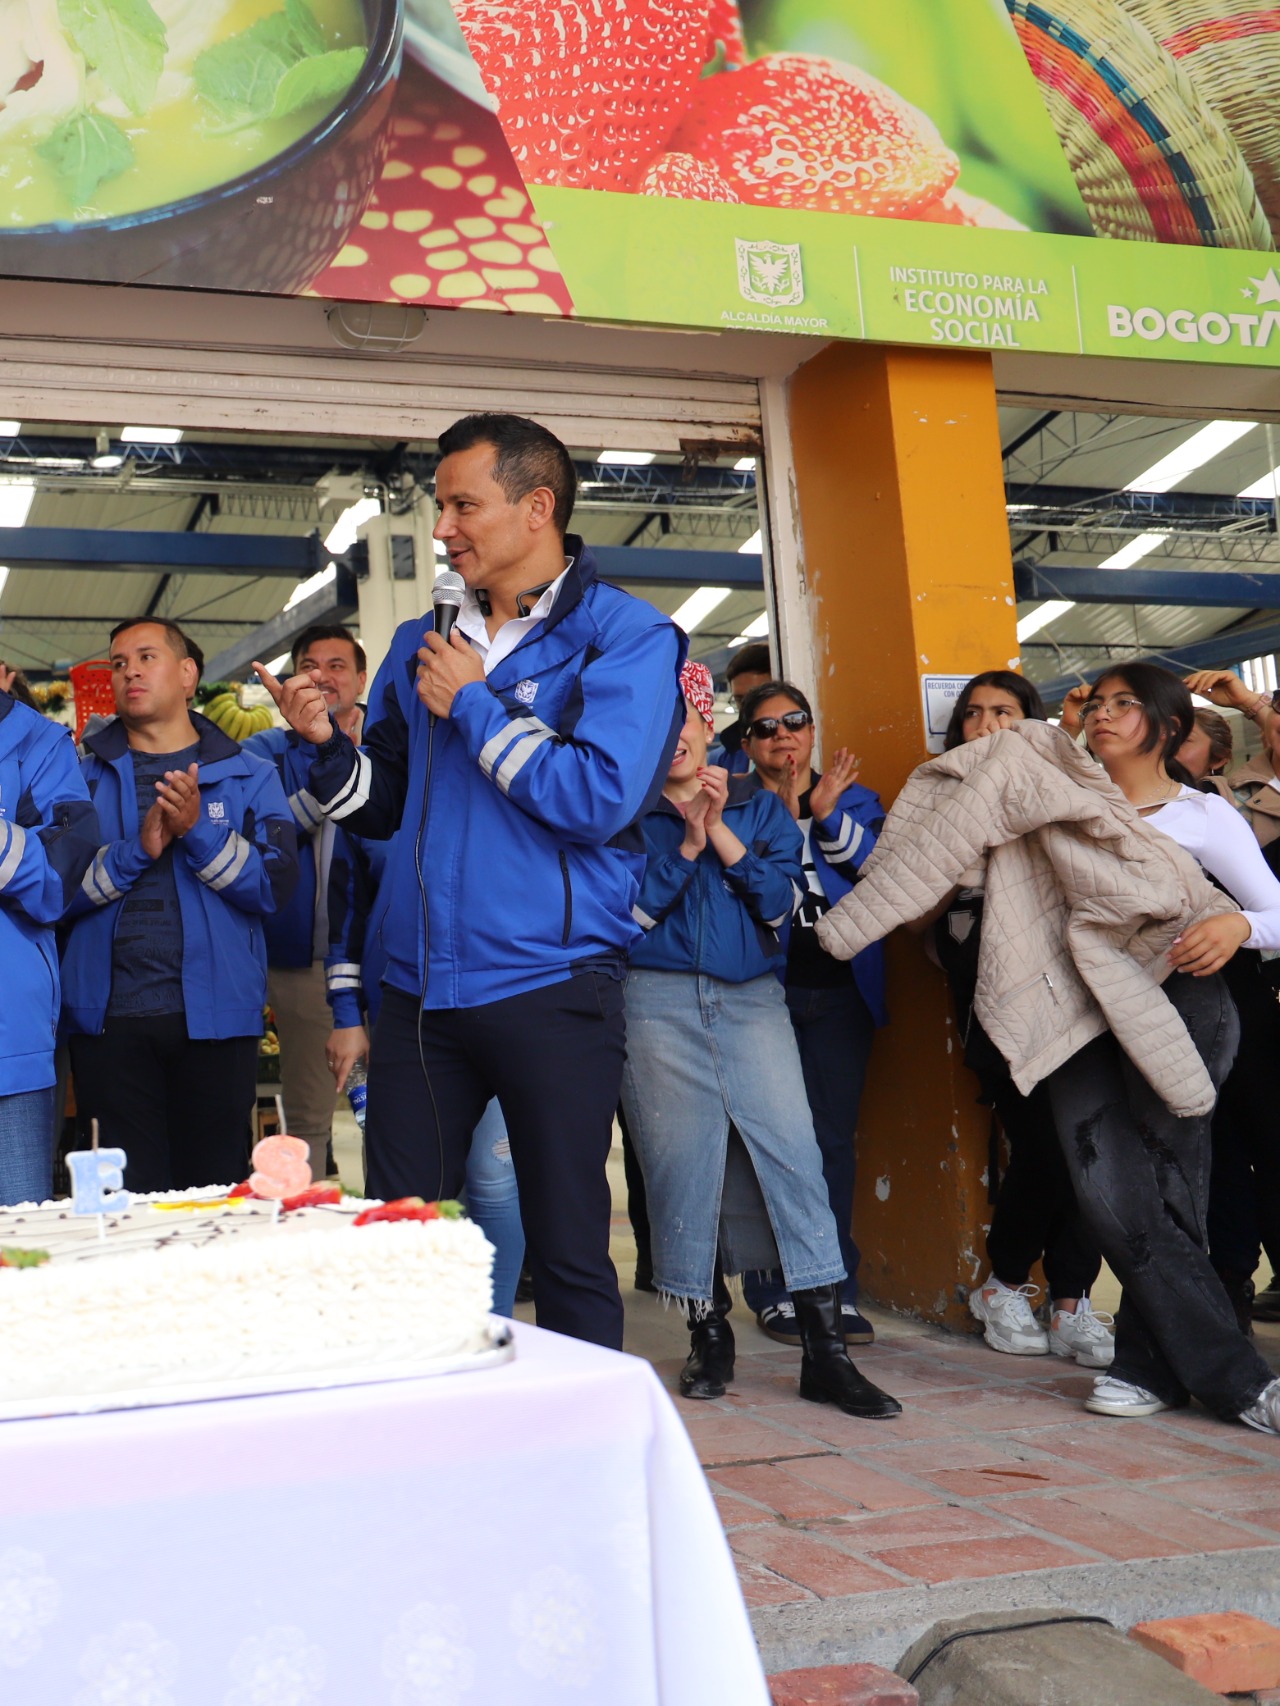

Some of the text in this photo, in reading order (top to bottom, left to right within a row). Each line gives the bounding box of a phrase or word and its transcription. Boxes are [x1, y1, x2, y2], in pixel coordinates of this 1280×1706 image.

[890, 266, 1048, 294] INSTITUTO PARA LA
[720, 310, 828, 328] ALCALDÍA MAYOR
[904, 289, 1040, 322] ECONOMÍA
[930, 318, 1020, 346] SOCIAL
[928, 682, 956, 690] RECUERDA
